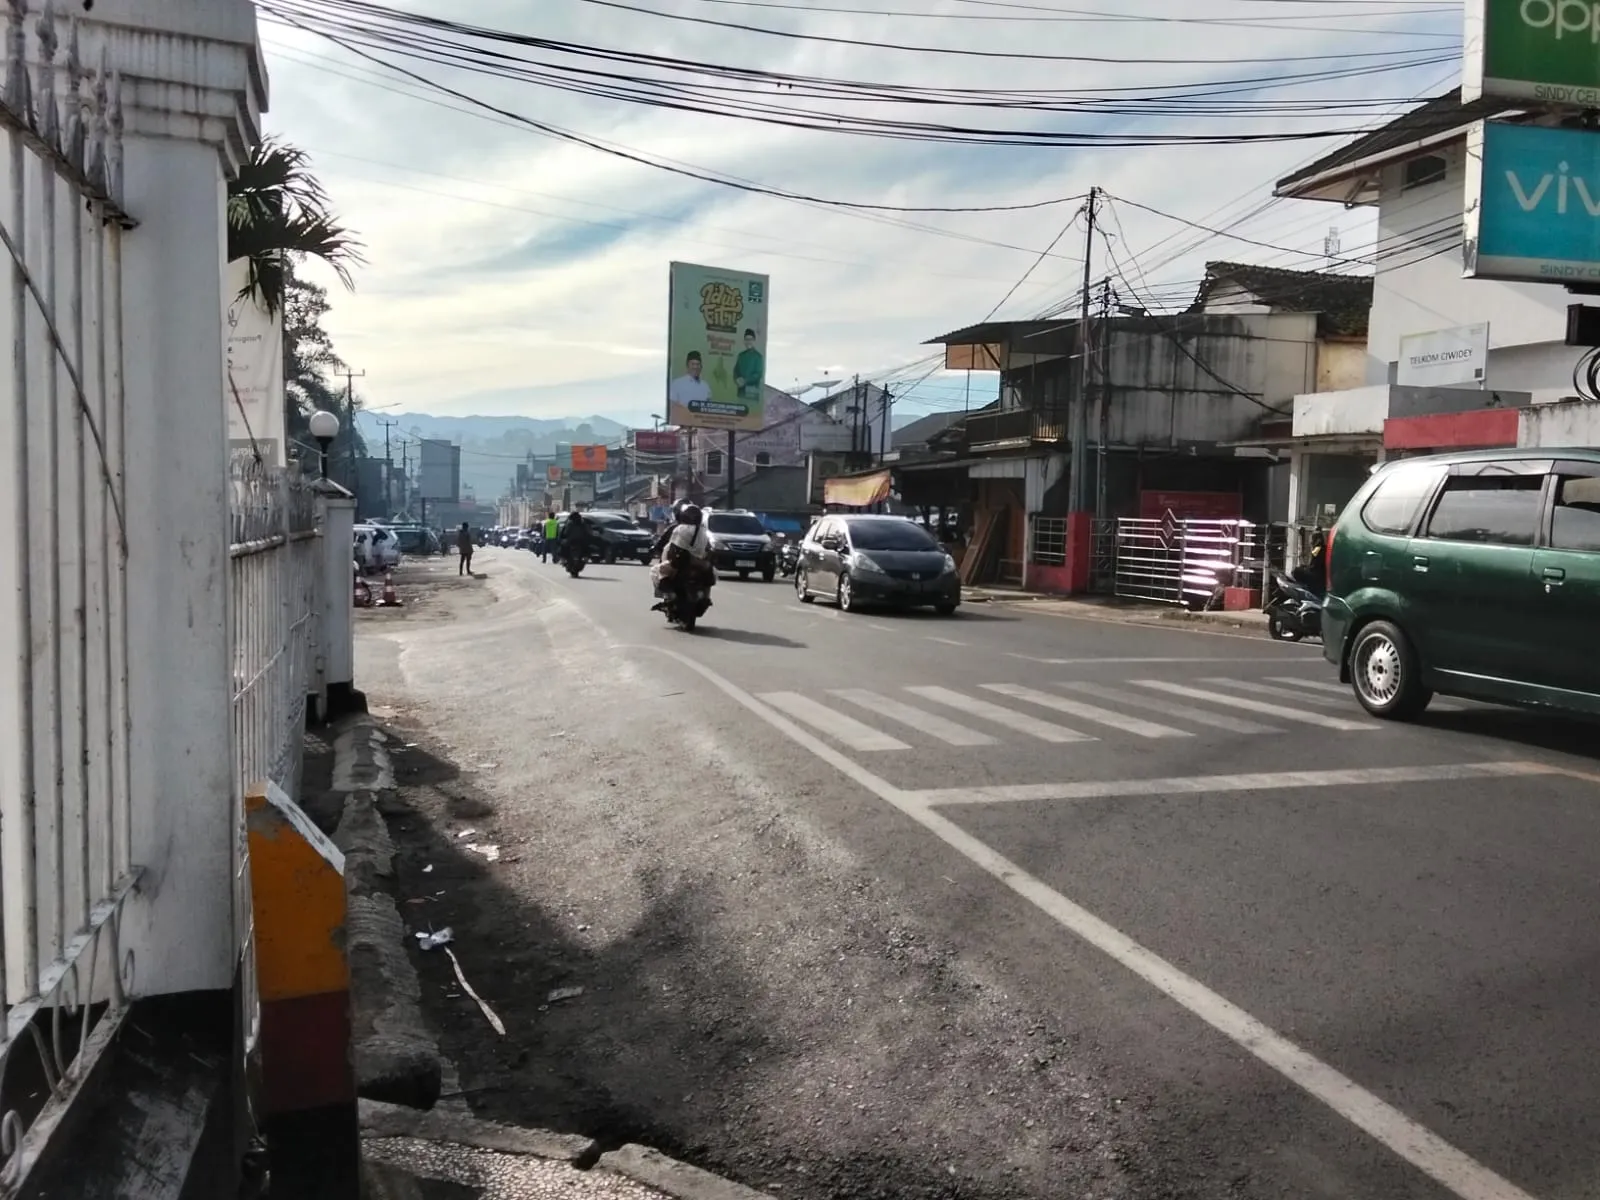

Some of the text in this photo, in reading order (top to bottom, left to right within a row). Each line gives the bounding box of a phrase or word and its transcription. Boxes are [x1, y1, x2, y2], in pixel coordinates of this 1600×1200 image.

[1535, 85, 1574, 102] SINDY
[1540, 264, 1585, 279] SINDY
[1409, 353, 1440, 366] TELKOM
[1440, 347, 1474, 361] CIWIDEY
